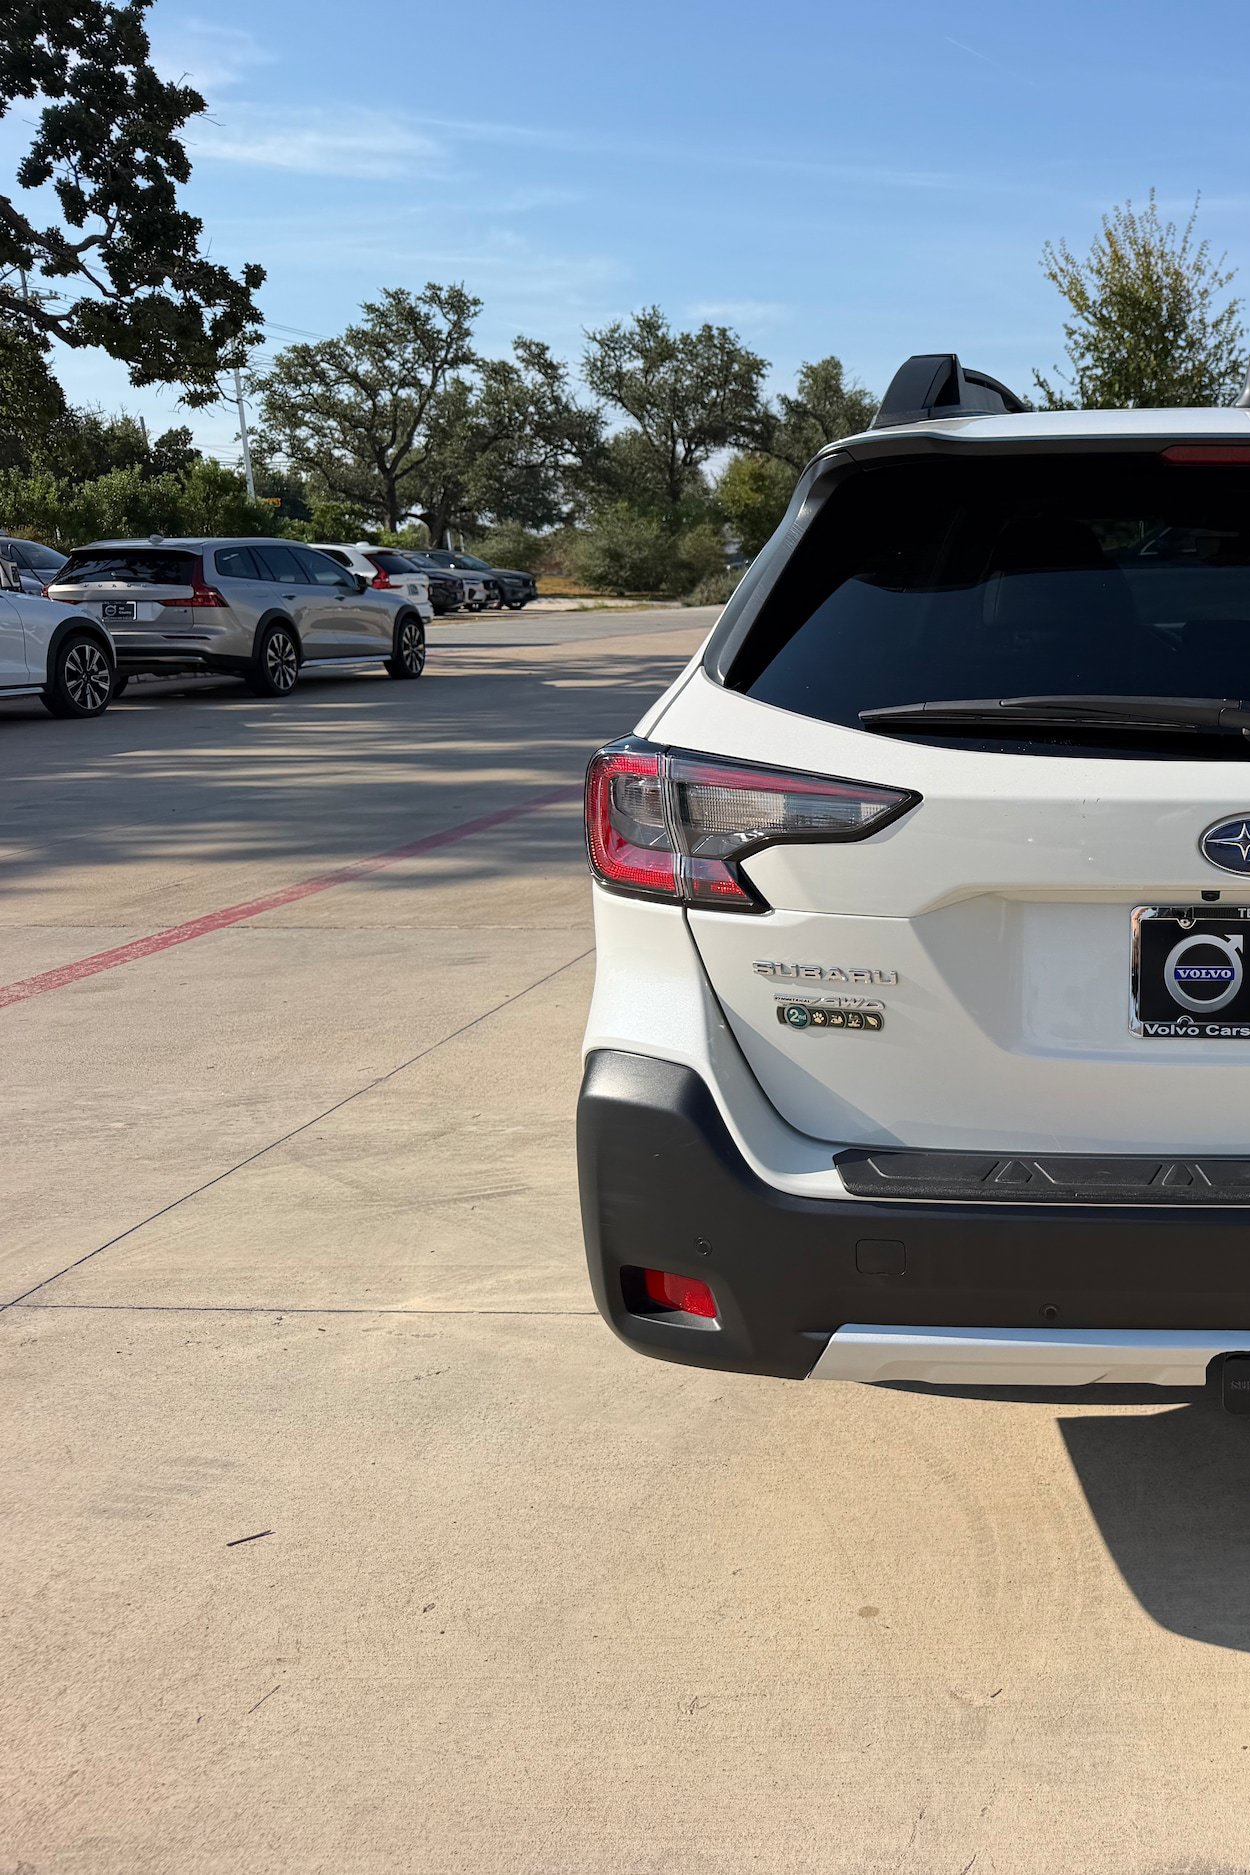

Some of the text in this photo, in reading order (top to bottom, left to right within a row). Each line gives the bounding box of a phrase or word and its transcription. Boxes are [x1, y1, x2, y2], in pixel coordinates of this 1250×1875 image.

[752, 960, 898, 985] SUBARU
[1177, 969, 1232, 979] VOLVO
[788, 1008, 807, 1024] 2nd
[1145, 1024, 1199, 1036] Volvo
[1205, 1025, 1250, 1037] Cars
